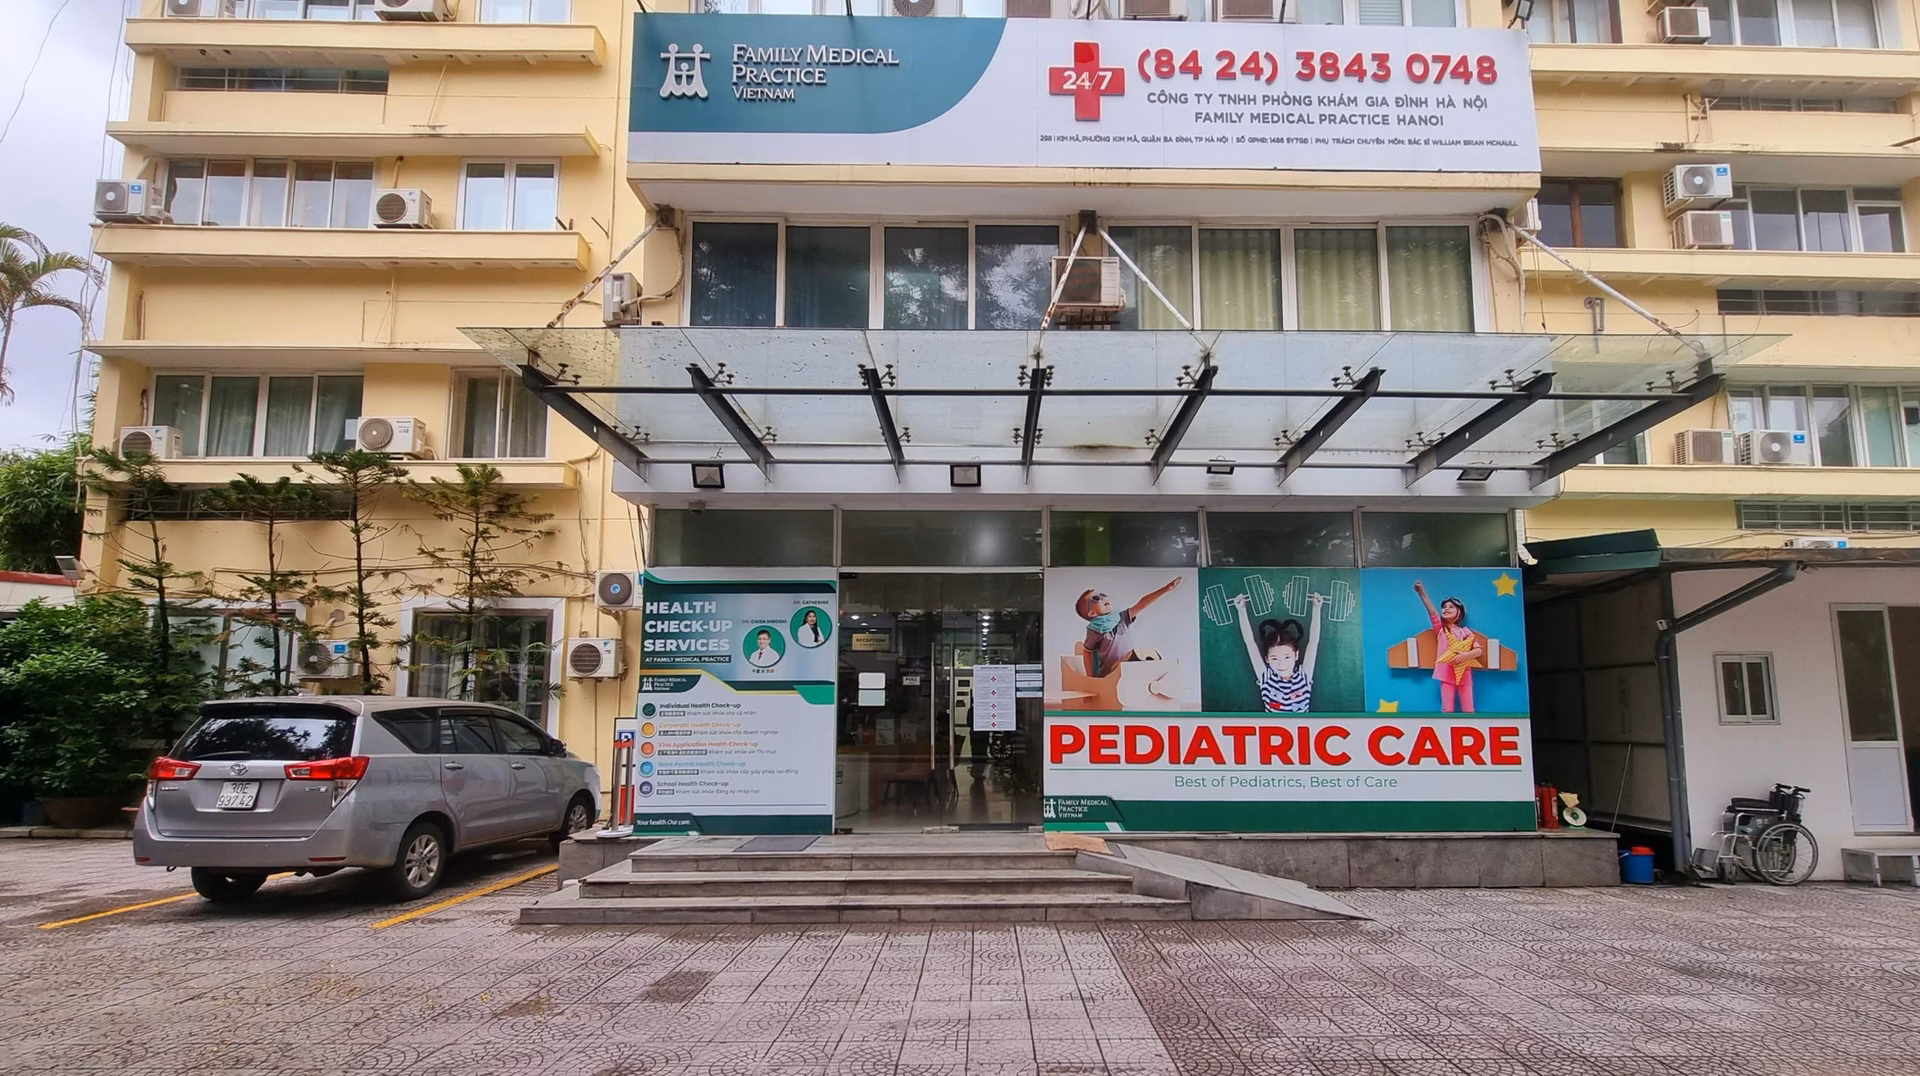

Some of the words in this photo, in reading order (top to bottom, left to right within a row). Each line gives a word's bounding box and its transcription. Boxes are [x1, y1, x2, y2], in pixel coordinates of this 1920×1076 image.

[733, 44, 803, 63] FAMILY
[806, 44, 900, 64] MEDICAL
[732, 64, 827, 84] PRACTICE
[1138, 48, 1203, 83] (84
[1215, 50, 1279, 86] 24)
[1295, 51, 1392, 83] 3843
[1405, 53, 1498, 85] 0748
[1063, 71, 1112, 90] 24/7
[732, 86, 796, 99] VIETNAM
[1147, 89, 1189, 104] CÔNG
[1194, 93, 1213, 105] TY
[1219, 94, 1257, 106] TNHH
[1262, 91, 1312, 106] PHÒNG
[1318, 93, 1358, 107] KHÁM
[1365, 96, 1389, 108] GIA
[1394, 94, 1429, 108] ĐÌNH
[1436, 94, 1456, 109] HÀ
[1463, 95, 1488, 111] NỘI
[1195, 112, 1245, 123] FAMILY
[1250, 113, 1315, 125] MEDICAL
[1319, 113, 1390, 125] PRACTICE
[1397, 115, 1444, 126] HANOI
[1112, 135, 1125, 143] KIM
[1205, 135, 1215, 143] HÀ
[1332, 136, 1355, 144] TRÁCH
[1408, 137, 1421, 145] BÁC
[645, 602, 717, 614] HEALTH
[644, 620, 733, 633] CHECK-UP
[643, 639, 730, 652] SERVICES
[1049, 724, 1351, 766] PEDIATRIC
[1368, 725, 1523, 766] CARE
[229, 782, 250, 794] 30E
[1174, 776, 1207, 788] Best
[1211, 775, 1226, 788] of
[1230, 775, 1305, 789] Pediatrics,
[1310, 776, 1342, 788] Best
[1346, 775, 1361, 788] of
[1364, 776, 1398, 788] Care
